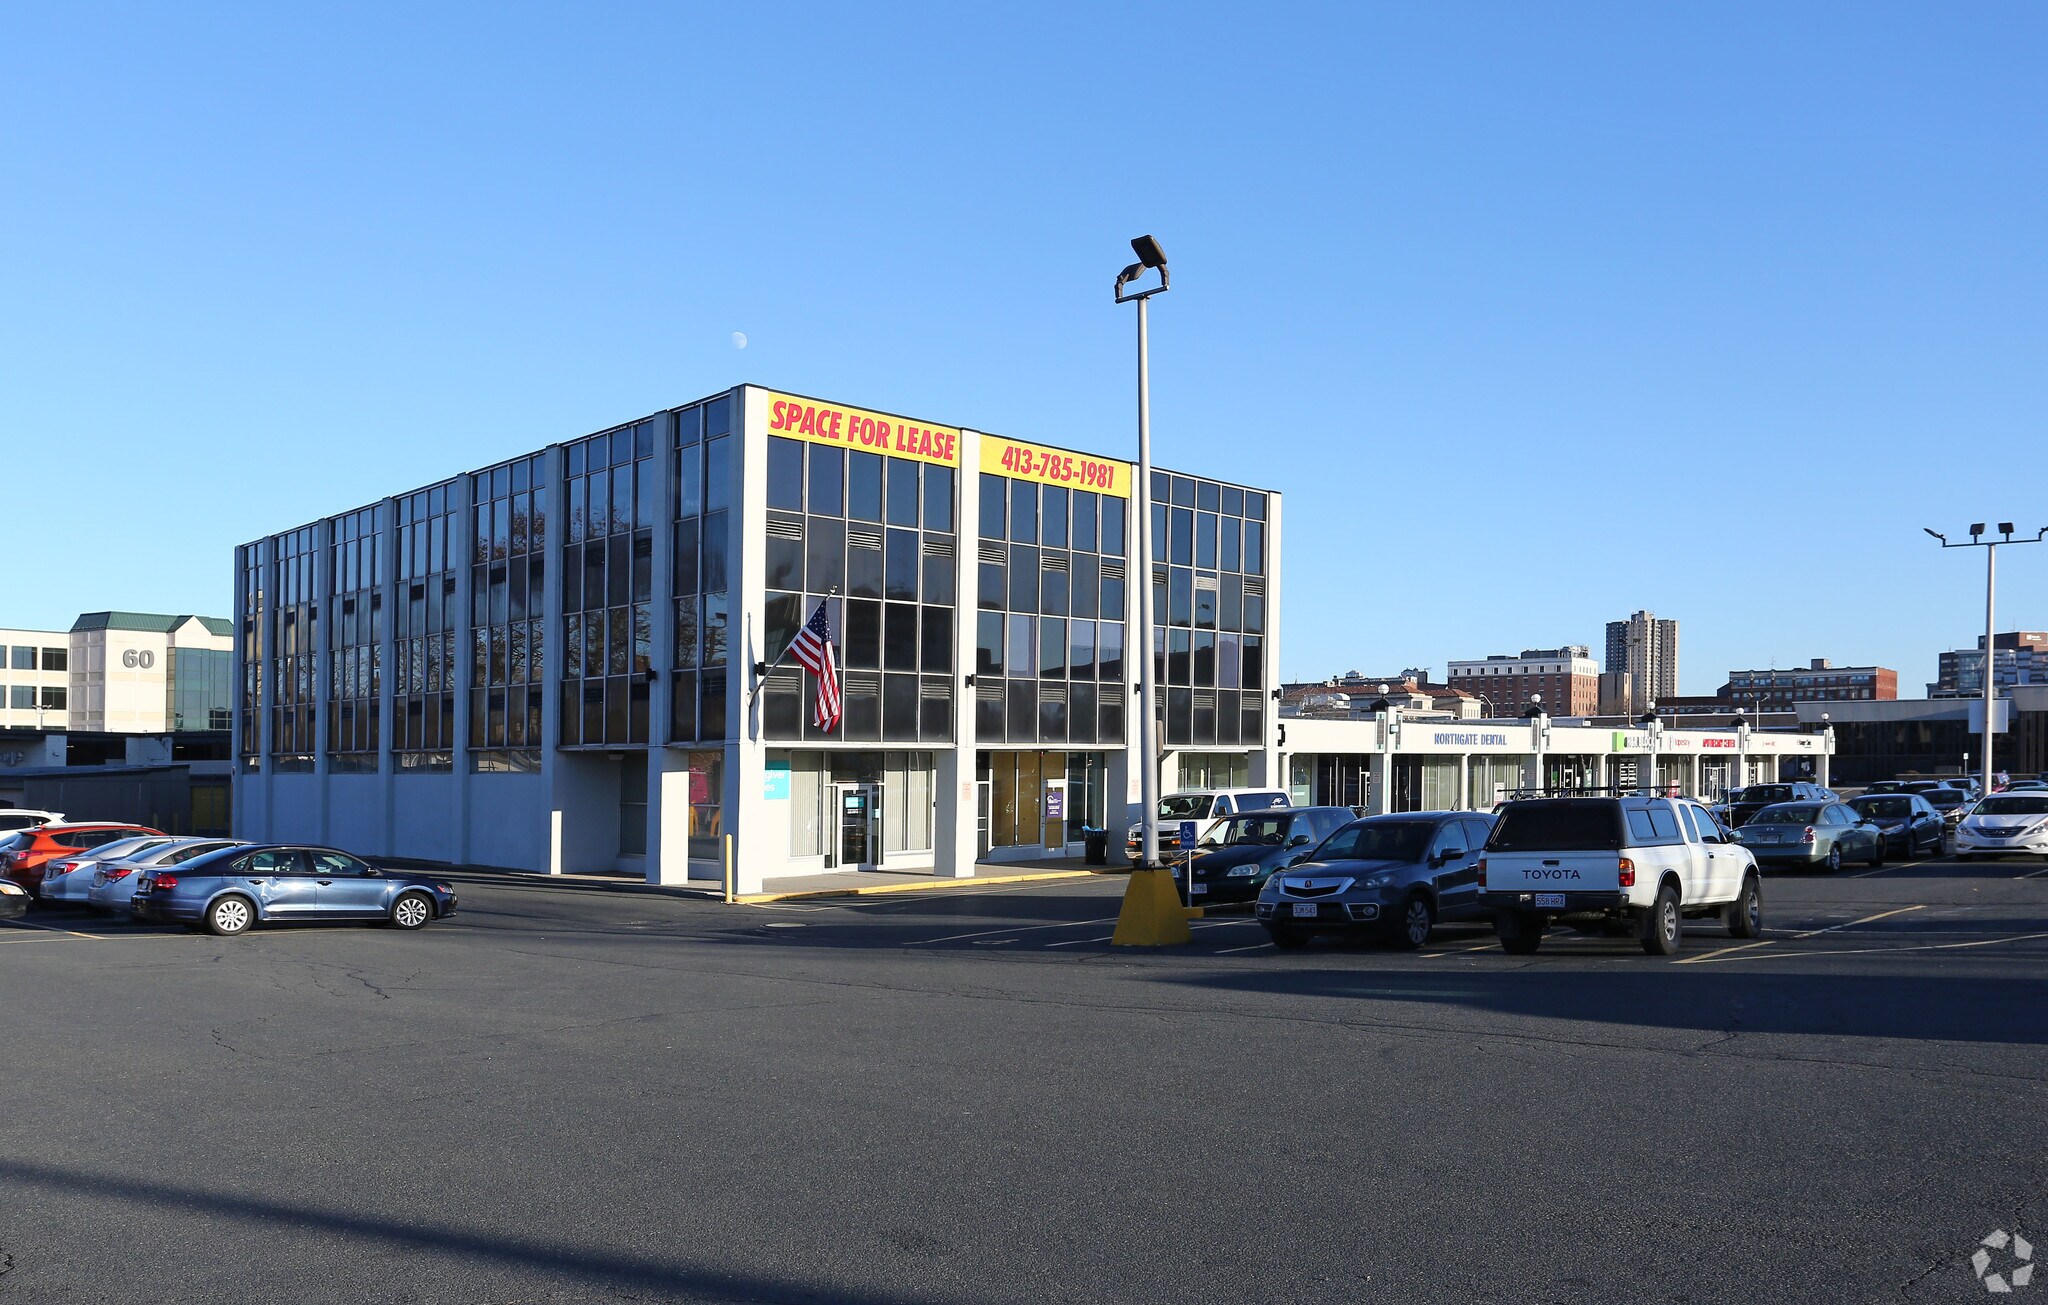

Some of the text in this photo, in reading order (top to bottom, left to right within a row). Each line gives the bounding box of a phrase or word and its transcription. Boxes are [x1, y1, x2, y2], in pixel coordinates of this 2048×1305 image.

[770, 400, 955, 461] SPACE FOR LEASE
[1001, 446, 1114, 489] 413-785-1981
[122, 649, 155, 669] 60
[1434, 733, 1507, 745] NORTHGATE DENTAL
[1522, 869, 1581, 880] TOYOTA
[1536, 897, 1550, 906] 558
